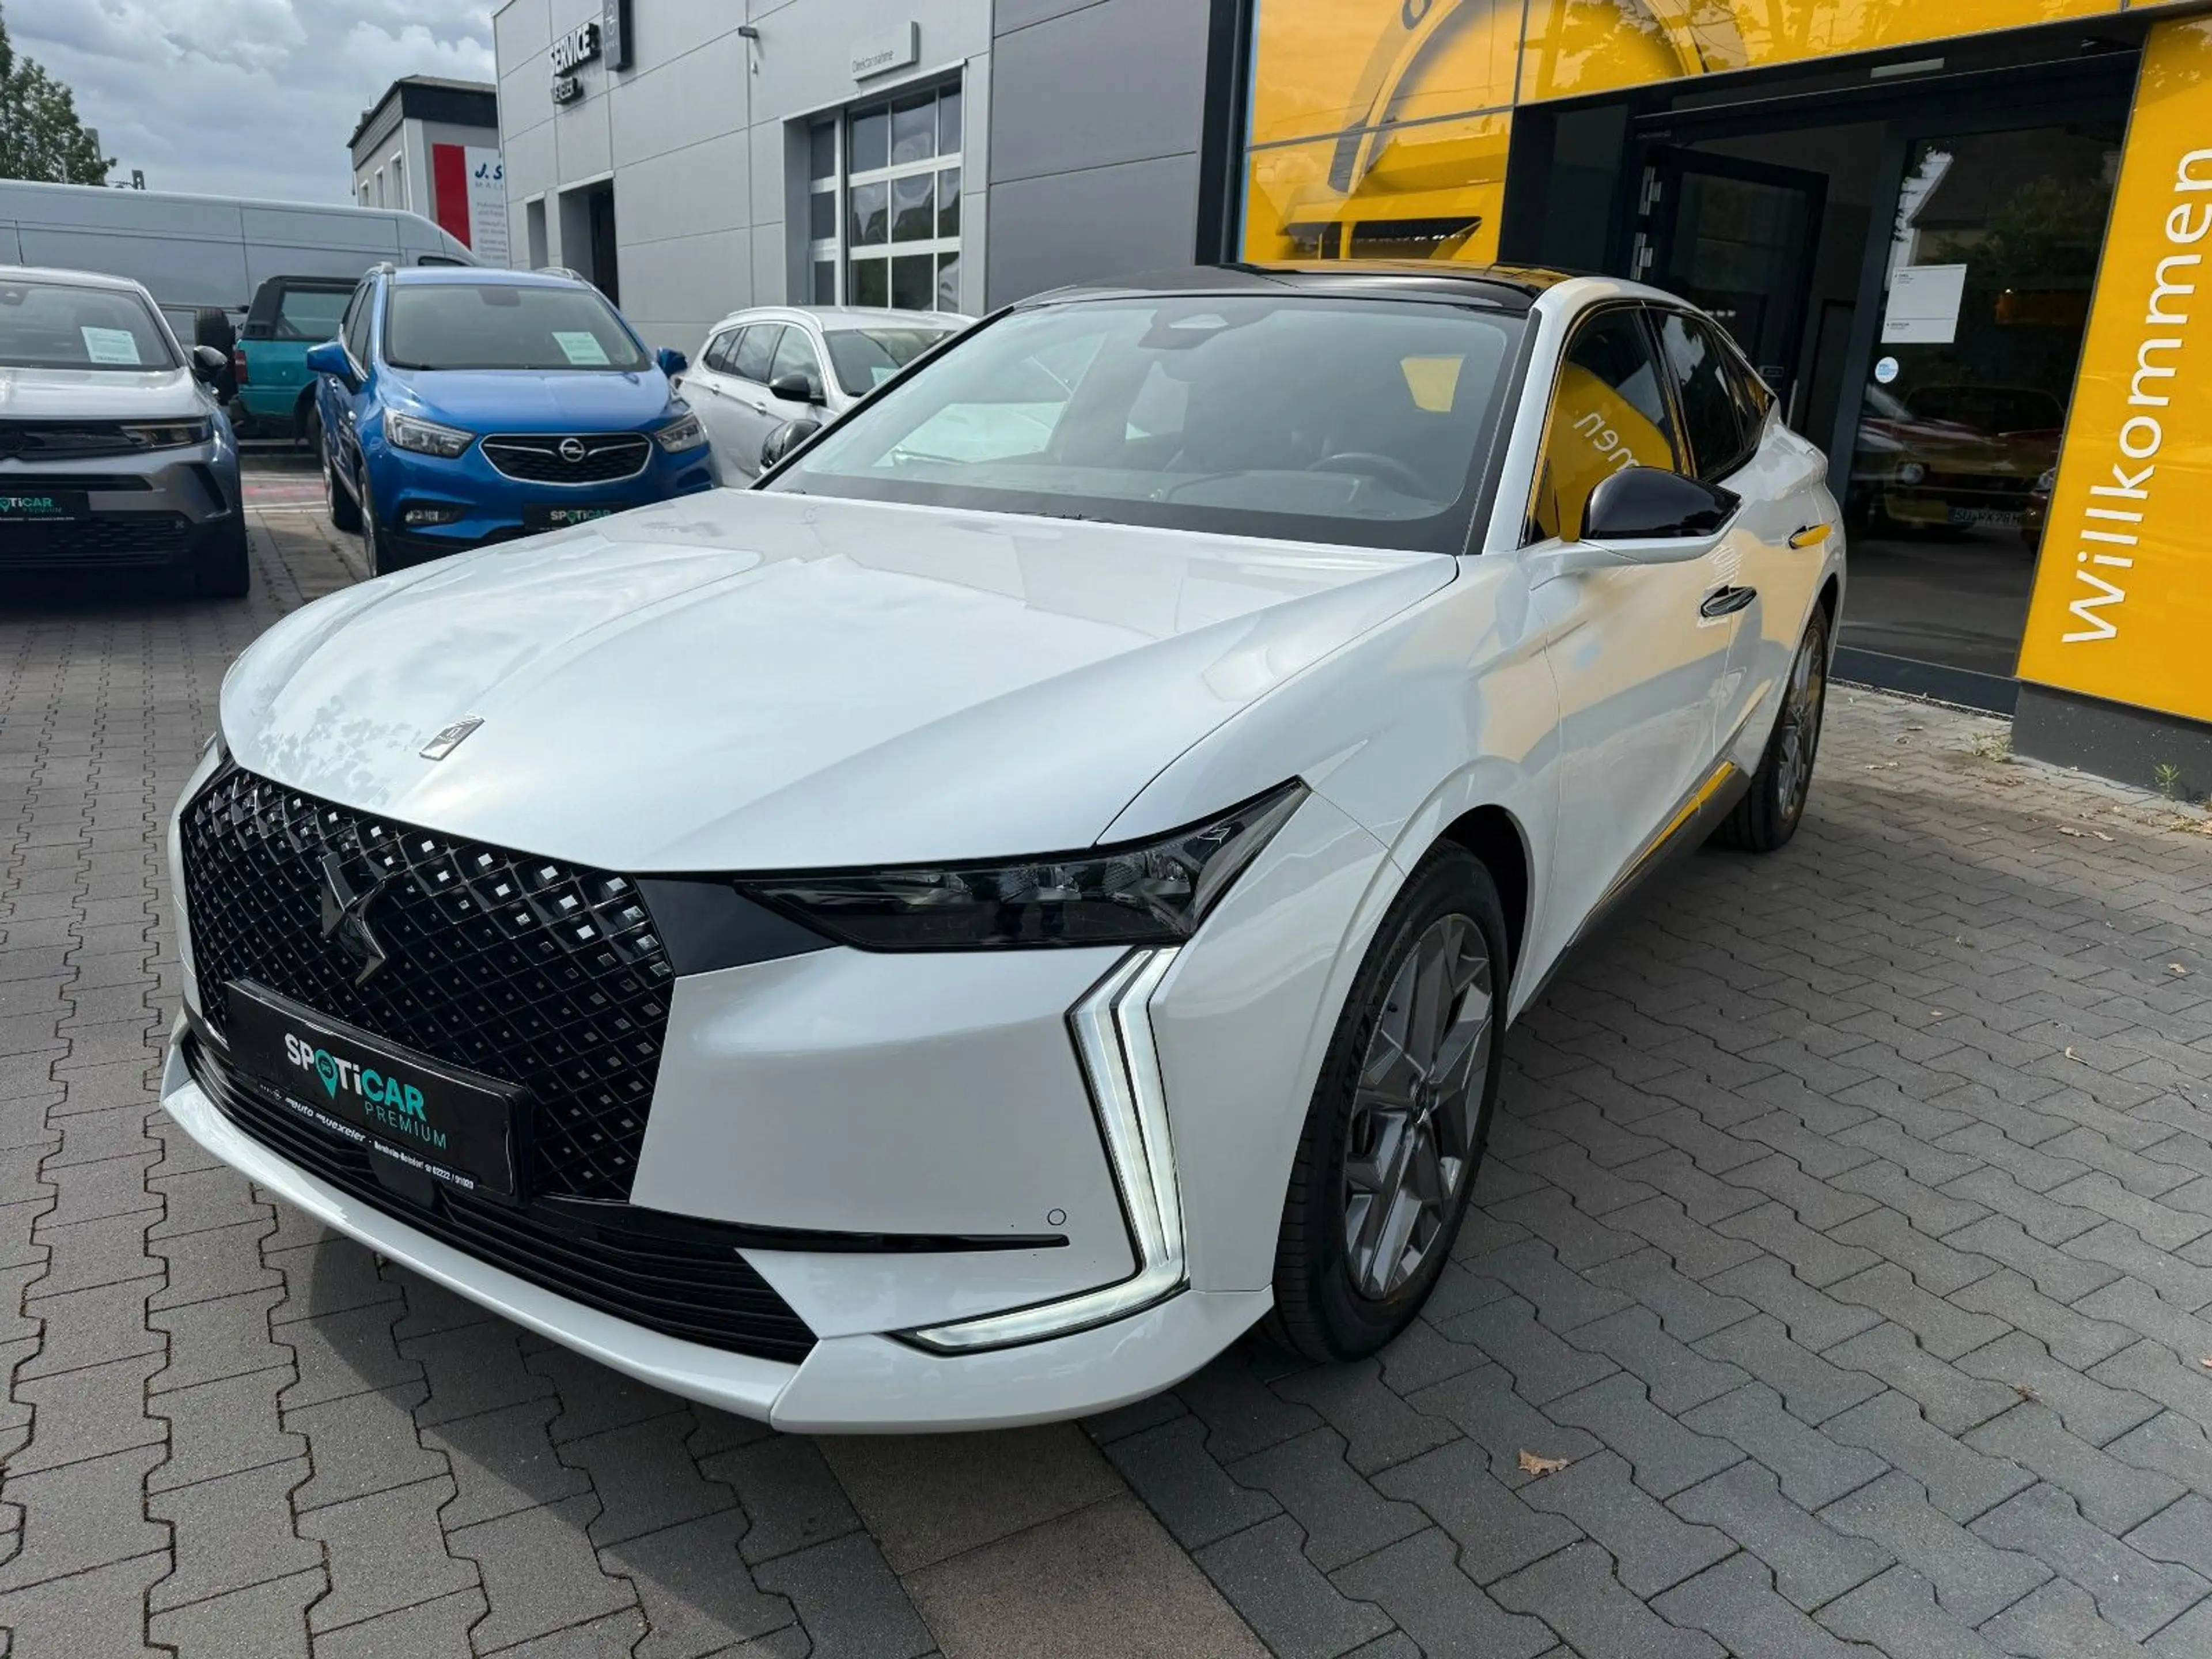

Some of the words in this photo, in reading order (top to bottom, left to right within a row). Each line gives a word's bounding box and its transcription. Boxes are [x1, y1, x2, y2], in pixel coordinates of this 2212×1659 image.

[549, 22, 591, 75] SERVICE
[2061, 149, 2212, 643] Willkommen
[365, 1101, 446, 1149] PREMIUM
